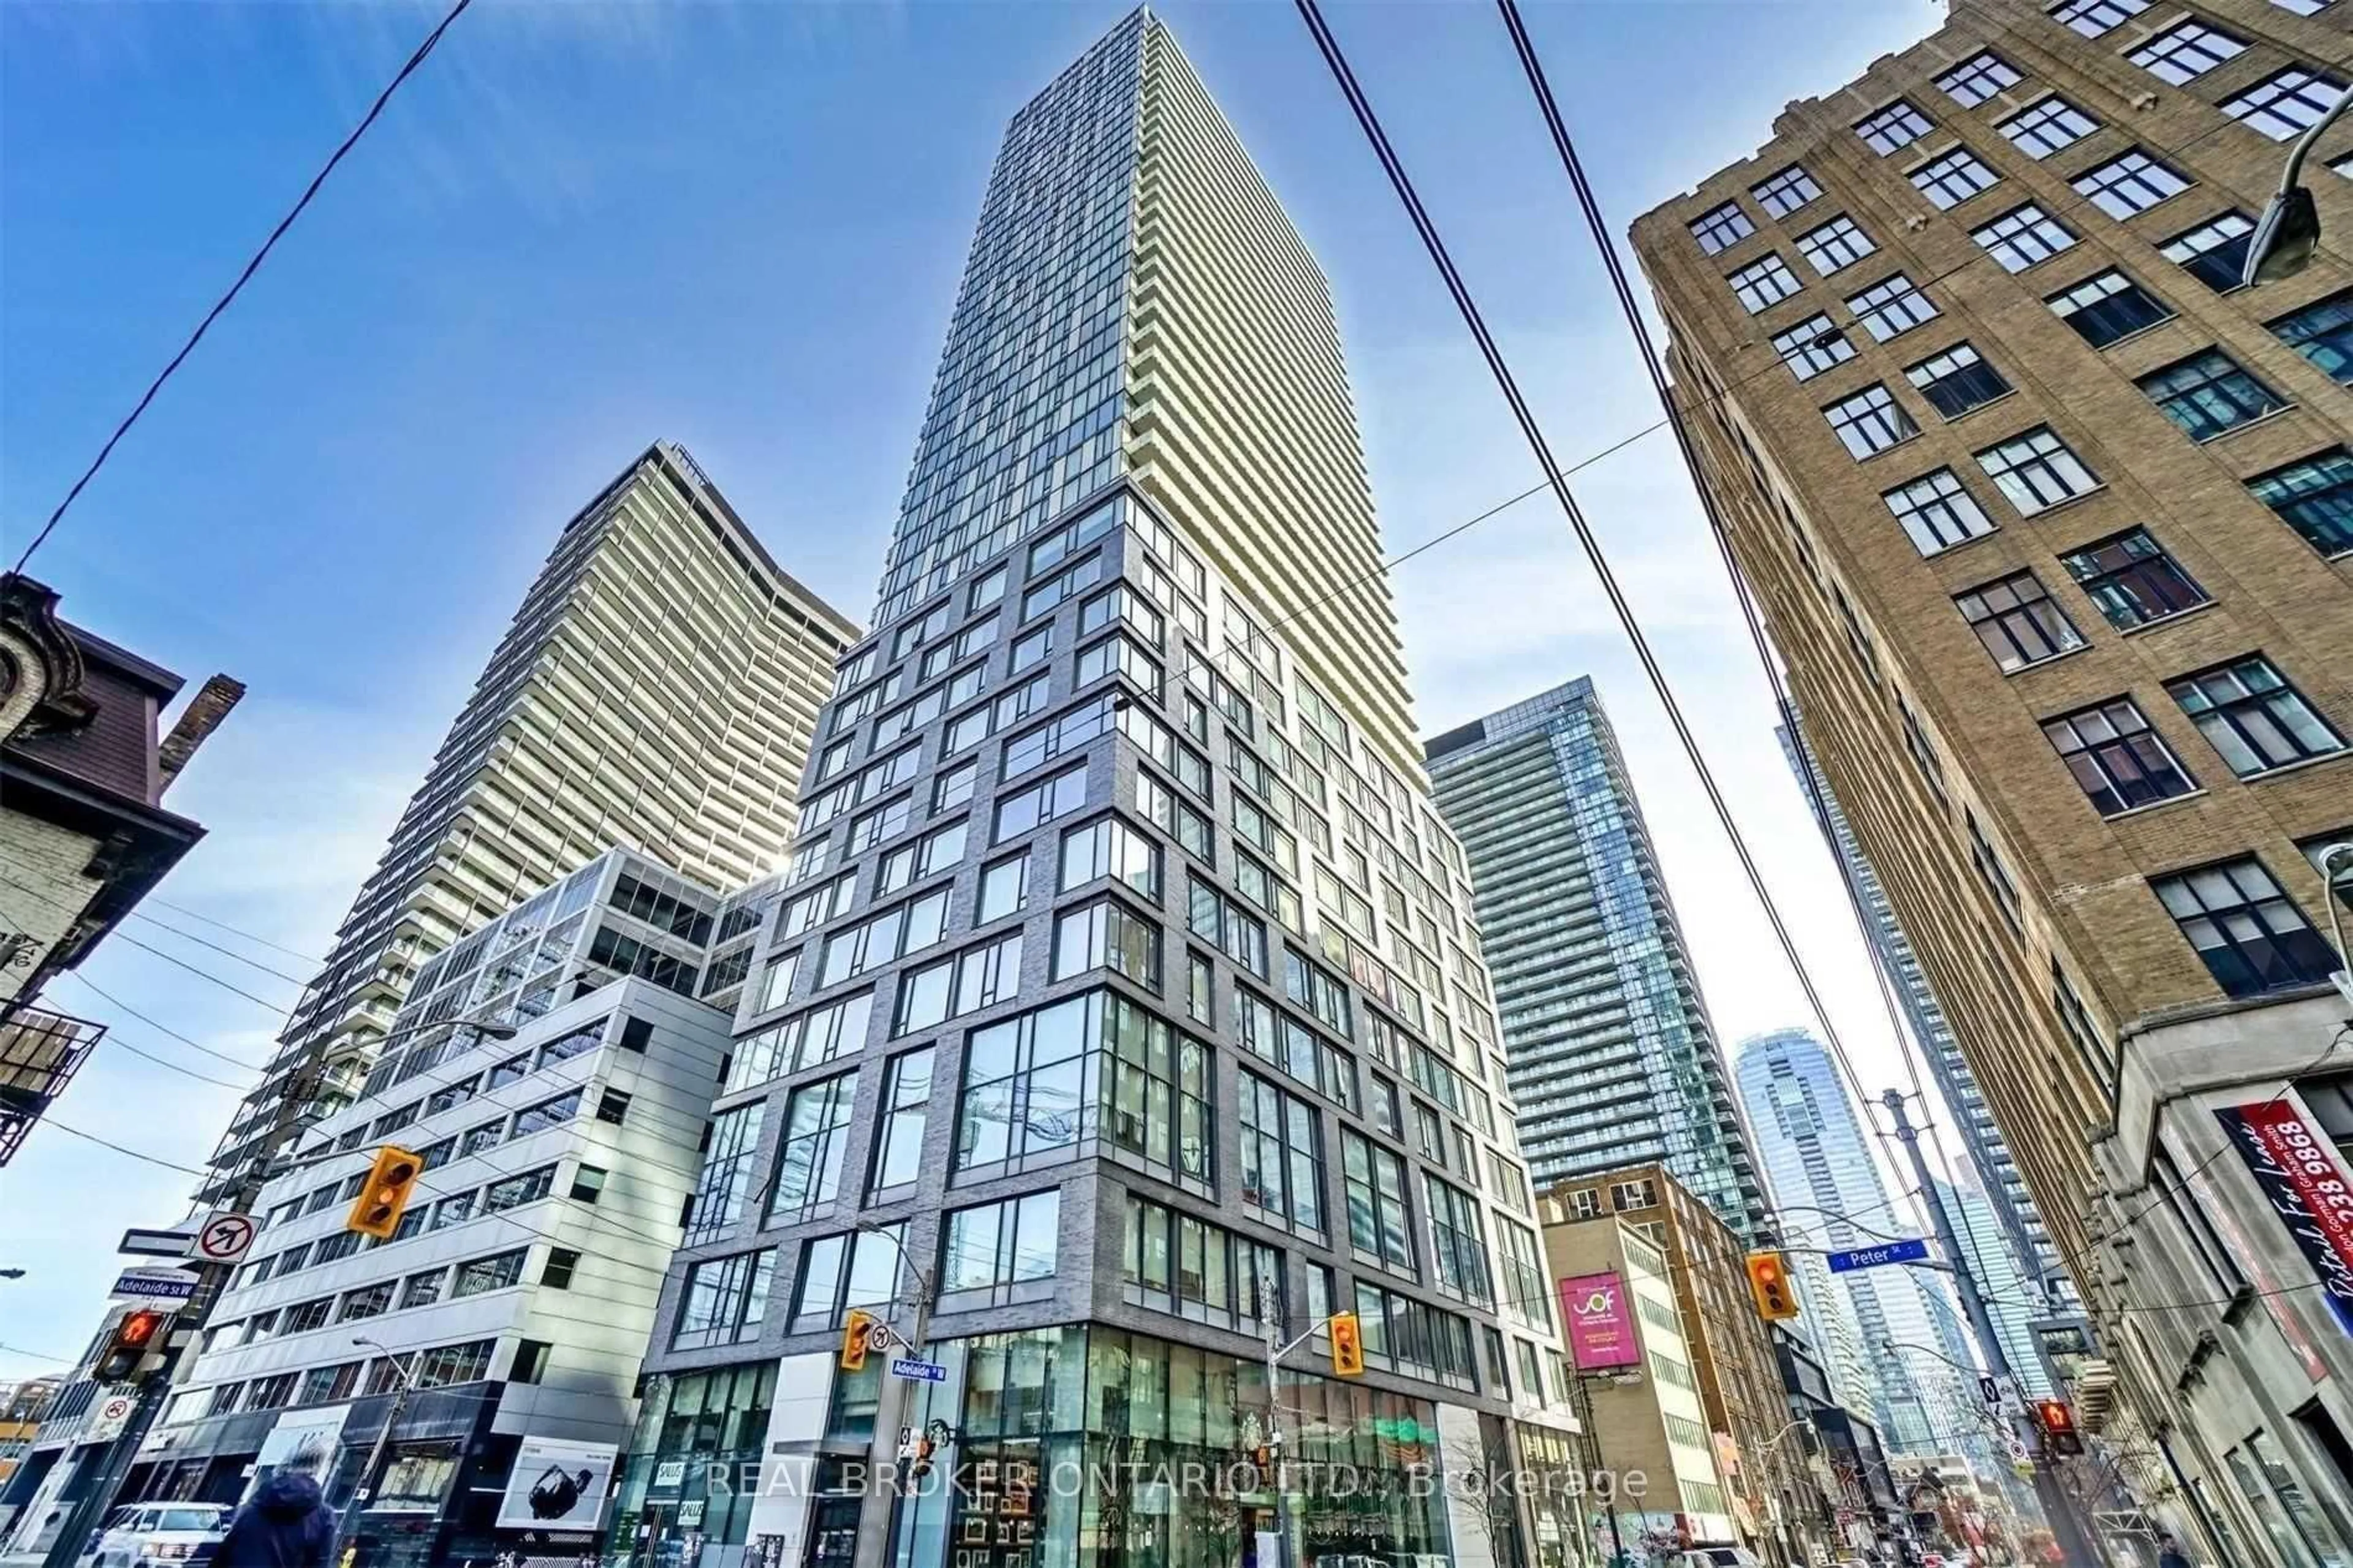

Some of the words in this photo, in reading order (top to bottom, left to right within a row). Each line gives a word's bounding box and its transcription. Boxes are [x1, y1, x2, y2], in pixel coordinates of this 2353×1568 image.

[2241, 1122, 2292, 1176] Lease
[2264, 1124, 2289, 1151] Smith
[2276, 1121, 2332, 1175] 9868
[2283, 1151, 2313, 1188] Graham
[2272, 1184, 2317, 1217] For
[2311, 1193, 2343, 1233] Gorman
[1849, 1249, 1889, 1266] Peter
[118, 1279, 169, 1294] Adelaide
[181, 1285, 193, 1295] W
[894, 1362, 930, 1377] Adelaide
